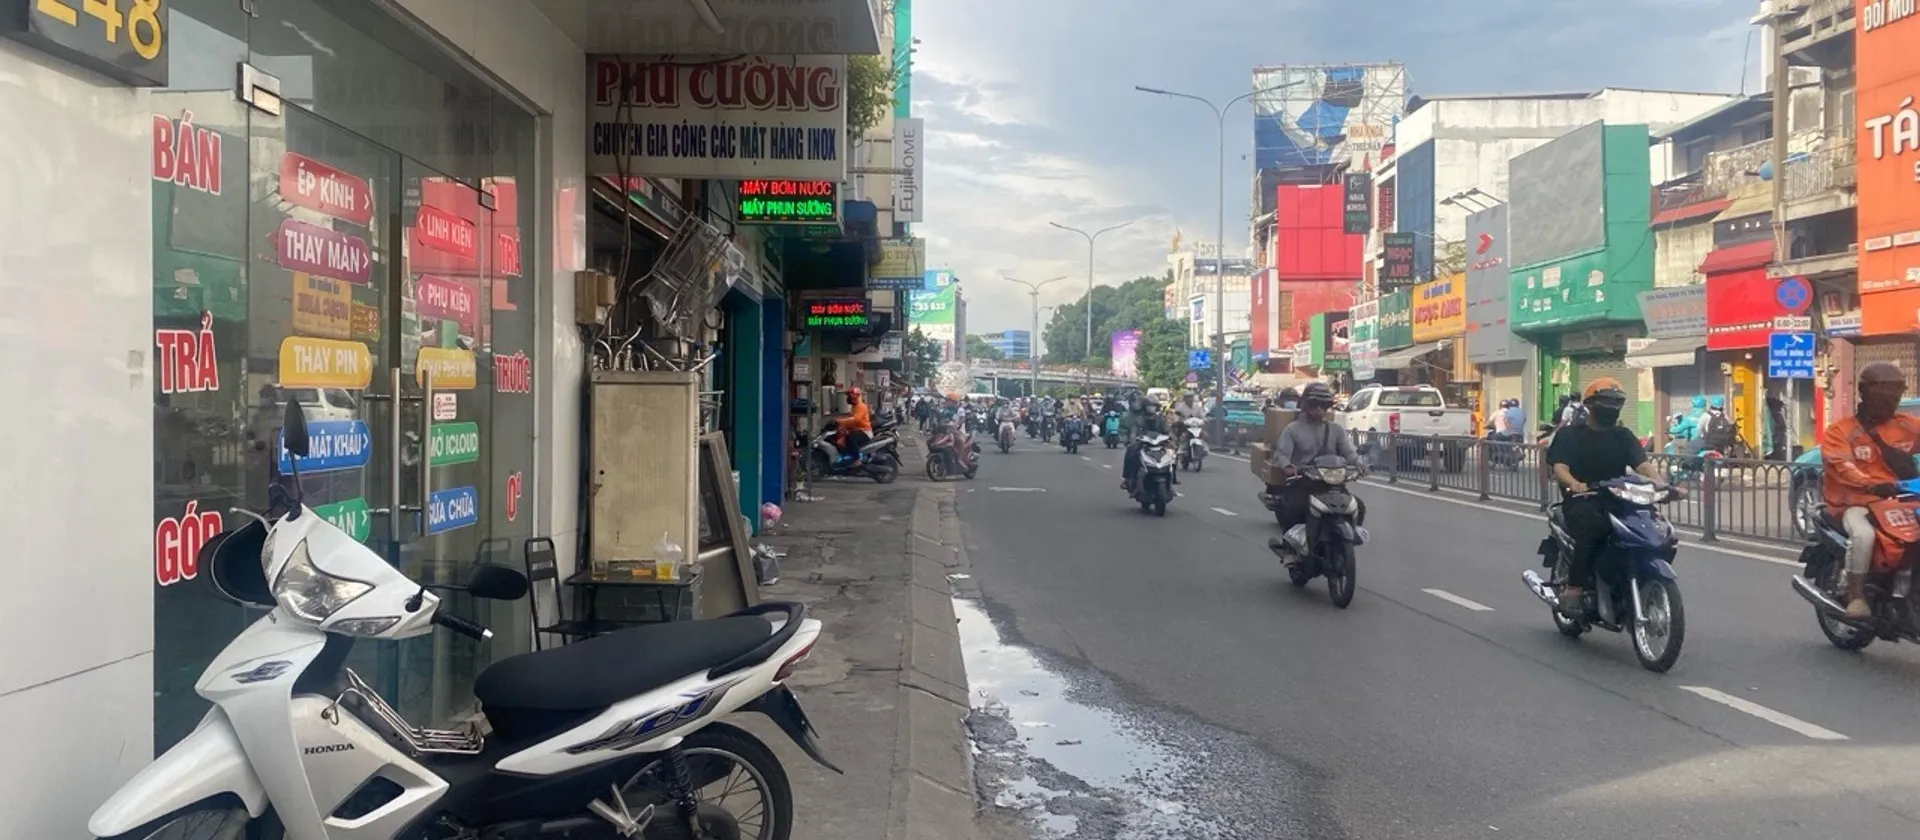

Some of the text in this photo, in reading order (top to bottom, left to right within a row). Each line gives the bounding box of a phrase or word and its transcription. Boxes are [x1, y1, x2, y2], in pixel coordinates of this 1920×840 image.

[688, 56, 840, 111] CƯỜNG
[153, 109, 221, 196] BÁN
[646, 122, 668, 157] GIA
[672, 118, 706, 158] CÔNG
[710, 120, 736, 159] CÁC
[739, 121, 767, 166] MẶT
[770, 121, 804, 160] HÀNG
[807, 127, 837, 161] INOX
[297, 161, 354, 211] ÉP KÍNH
[743, 180, 832, 195] MÁY BƠM NƯỚC
[743, 197, 765, 214] MÁY
[766, 201, 795, 215] PHUN
[285, 229, 360, 274] THAY MÀN
[427, 214, 472, 253] LINH KIỆN
[427, 283, 471, 318] PHỤ KIỆN
[157, 310, 219, 394] TRẢ
[294, 344, 358, 375] THAY PIN
[495, 350, 533, 393] TRƯỚC
[308, 428, 332, 465] MẬT
[334, 421, 361, 458] KHẨU
[445, 432, 478, 455] ICLOUD
[448, 491, 475, 520] CHỮA
[304, 742, 355, 755] HONDA
